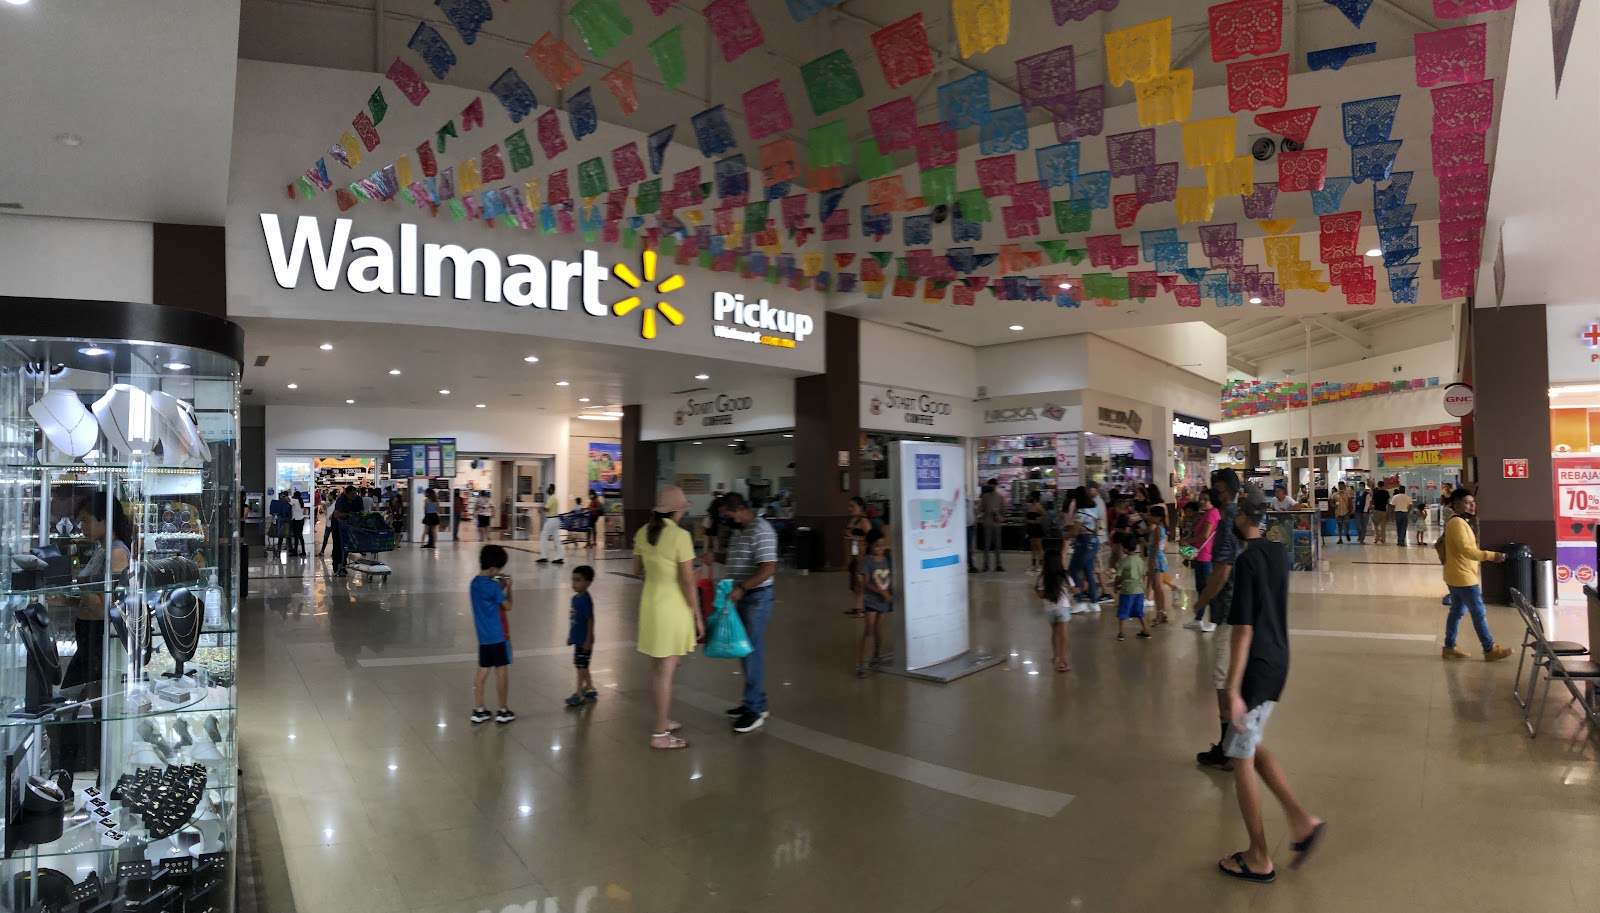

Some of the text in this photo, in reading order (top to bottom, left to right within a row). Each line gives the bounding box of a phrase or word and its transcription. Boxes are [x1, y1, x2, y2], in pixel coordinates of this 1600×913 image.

[259, 213, 609, 317] Walmart
[712, 291, 814, 341] Pickup
[1375, 432, 1405, 449] SUPER
[1412, 449, 1440, 465] GRATIS
